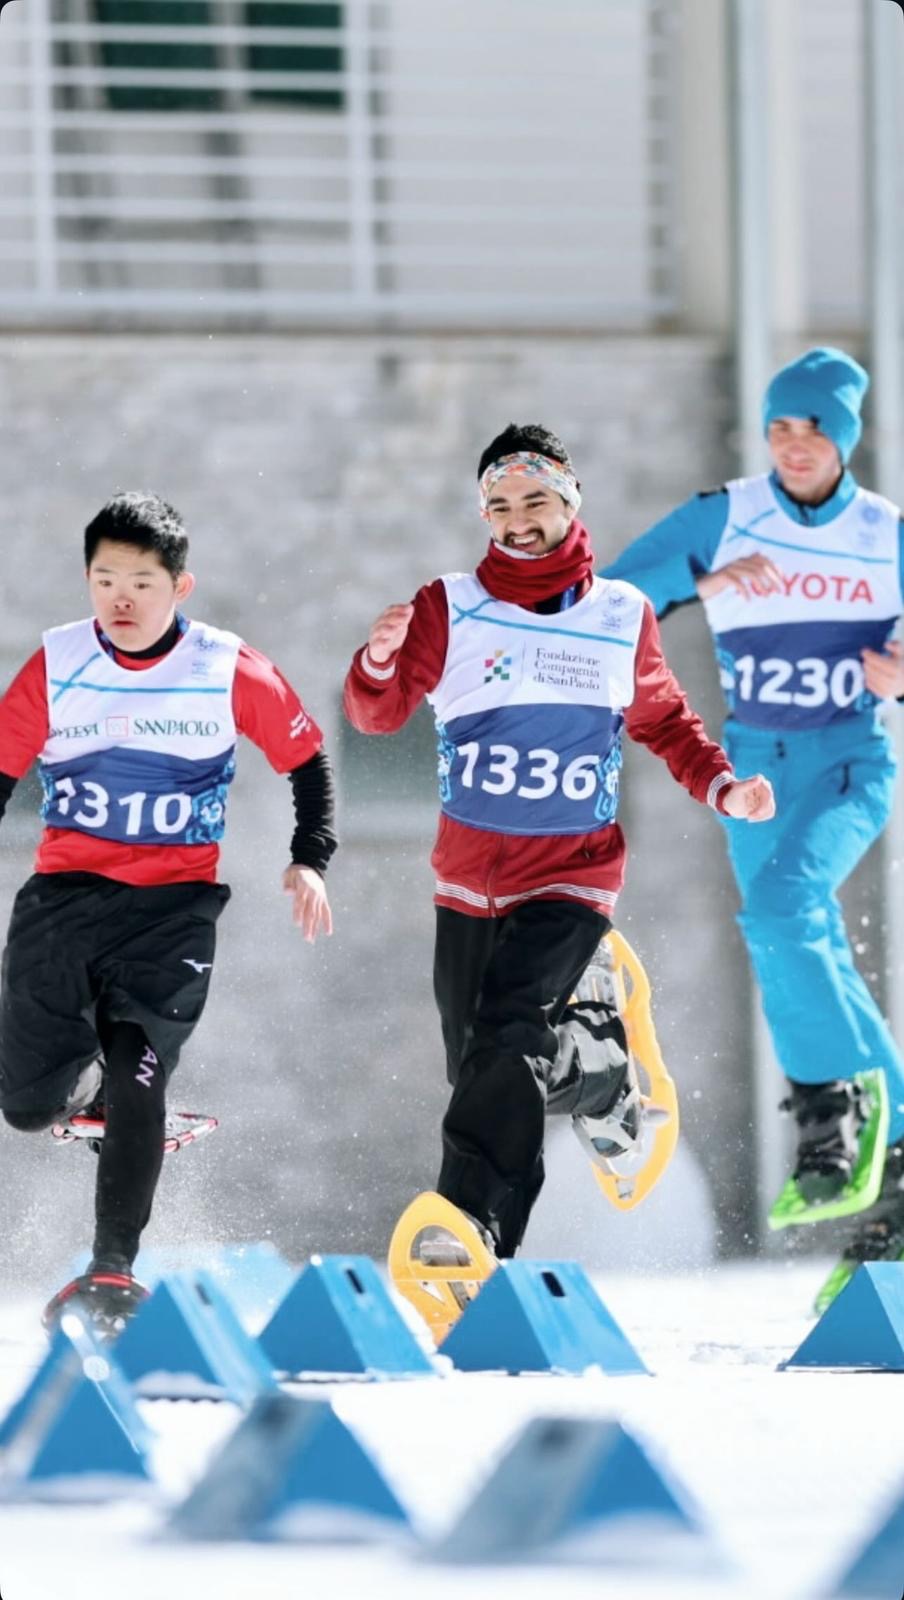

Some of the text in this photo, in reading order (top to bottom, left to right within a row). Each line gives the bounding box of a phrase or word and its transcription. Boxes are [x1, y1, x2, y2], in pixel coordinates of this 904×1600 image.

[736, 572, 874, 604] YOTA
[533, 660, 600, 679] Compagnia
[535, 647, 600, 666] Fondazione
[532, 671, 545, 683] di
[569, 675, 600, 691] Paolo
[734, 654, 863, 708] 1230
[133, 718, 220, 737] SANPAOLO
[456, 741, 600, 801] 1336
[55, 776, 192, 836] 1310
